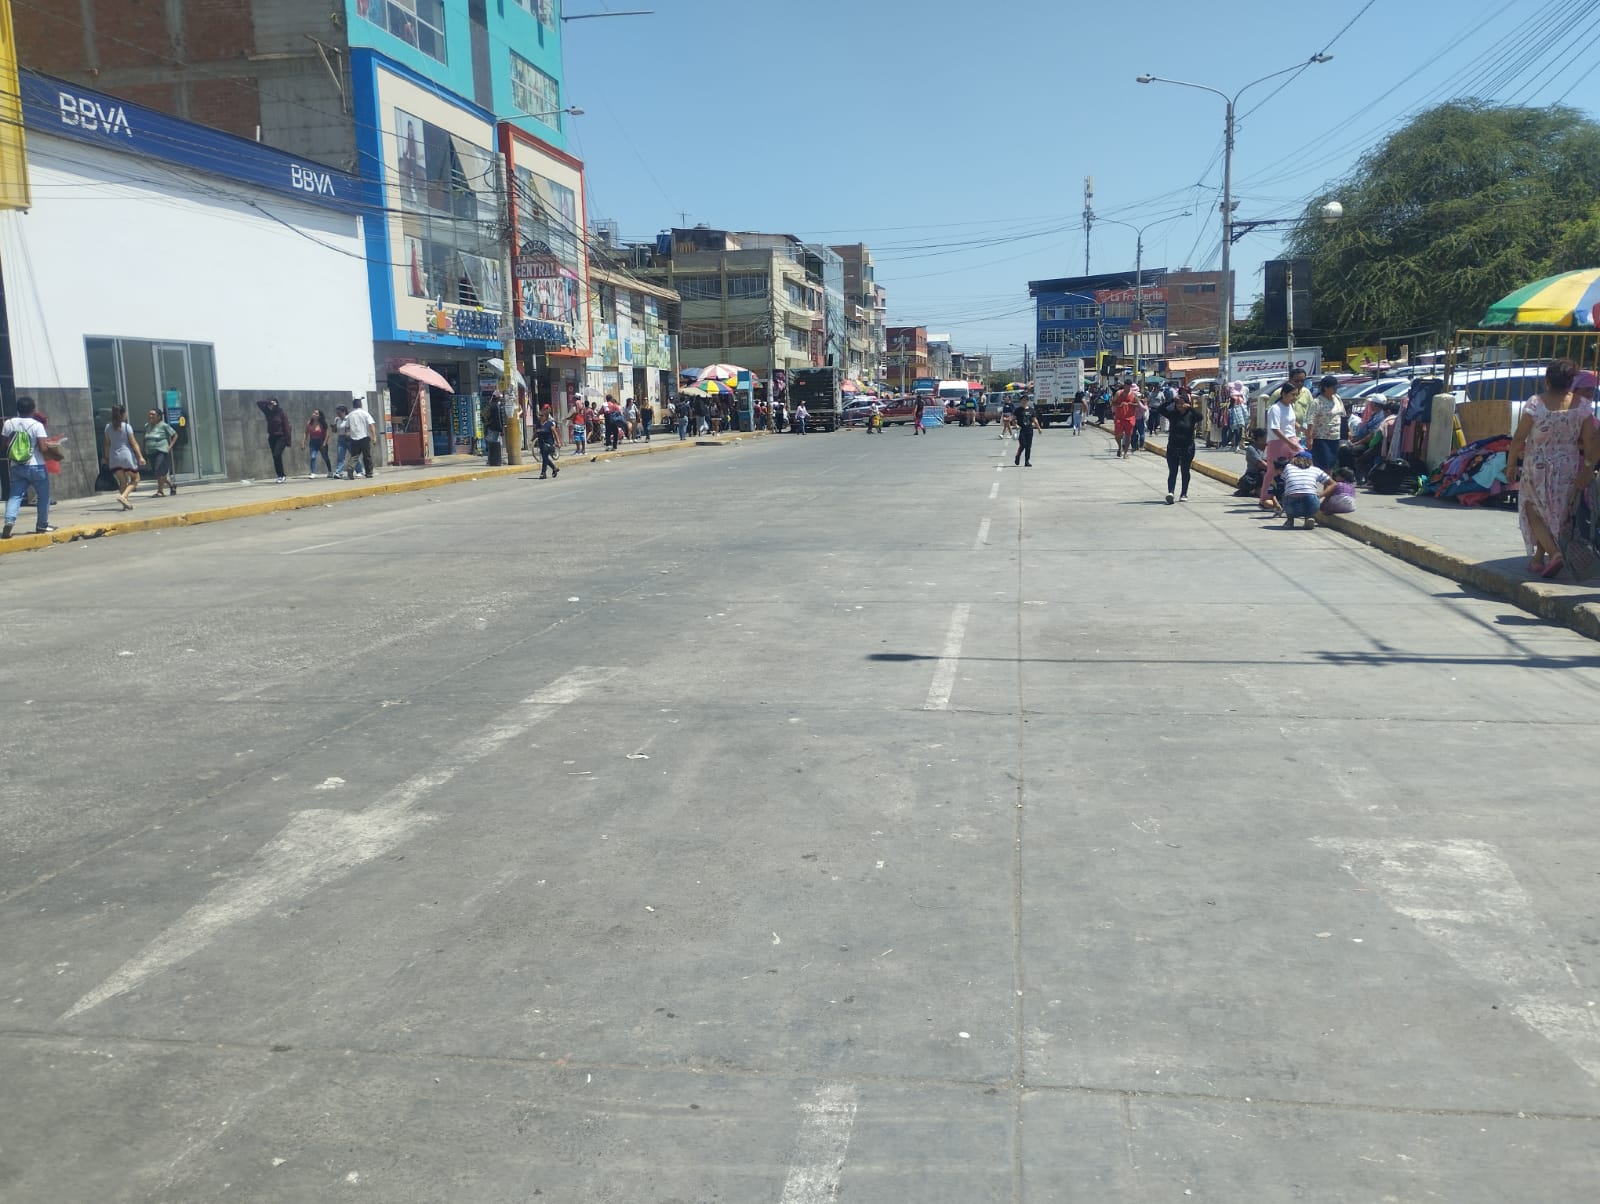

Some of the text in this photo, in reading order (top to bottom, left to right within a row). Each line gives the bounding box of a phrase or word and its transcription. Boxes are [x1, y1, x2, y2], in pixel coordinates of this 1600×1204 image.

[59, 92, 133, 137] BBVA
[290, 163, 335, 196] BBVA
[515, 262, 556, 277] CENTRAL
[1237, 360, 1307, 372] TRUJILO
